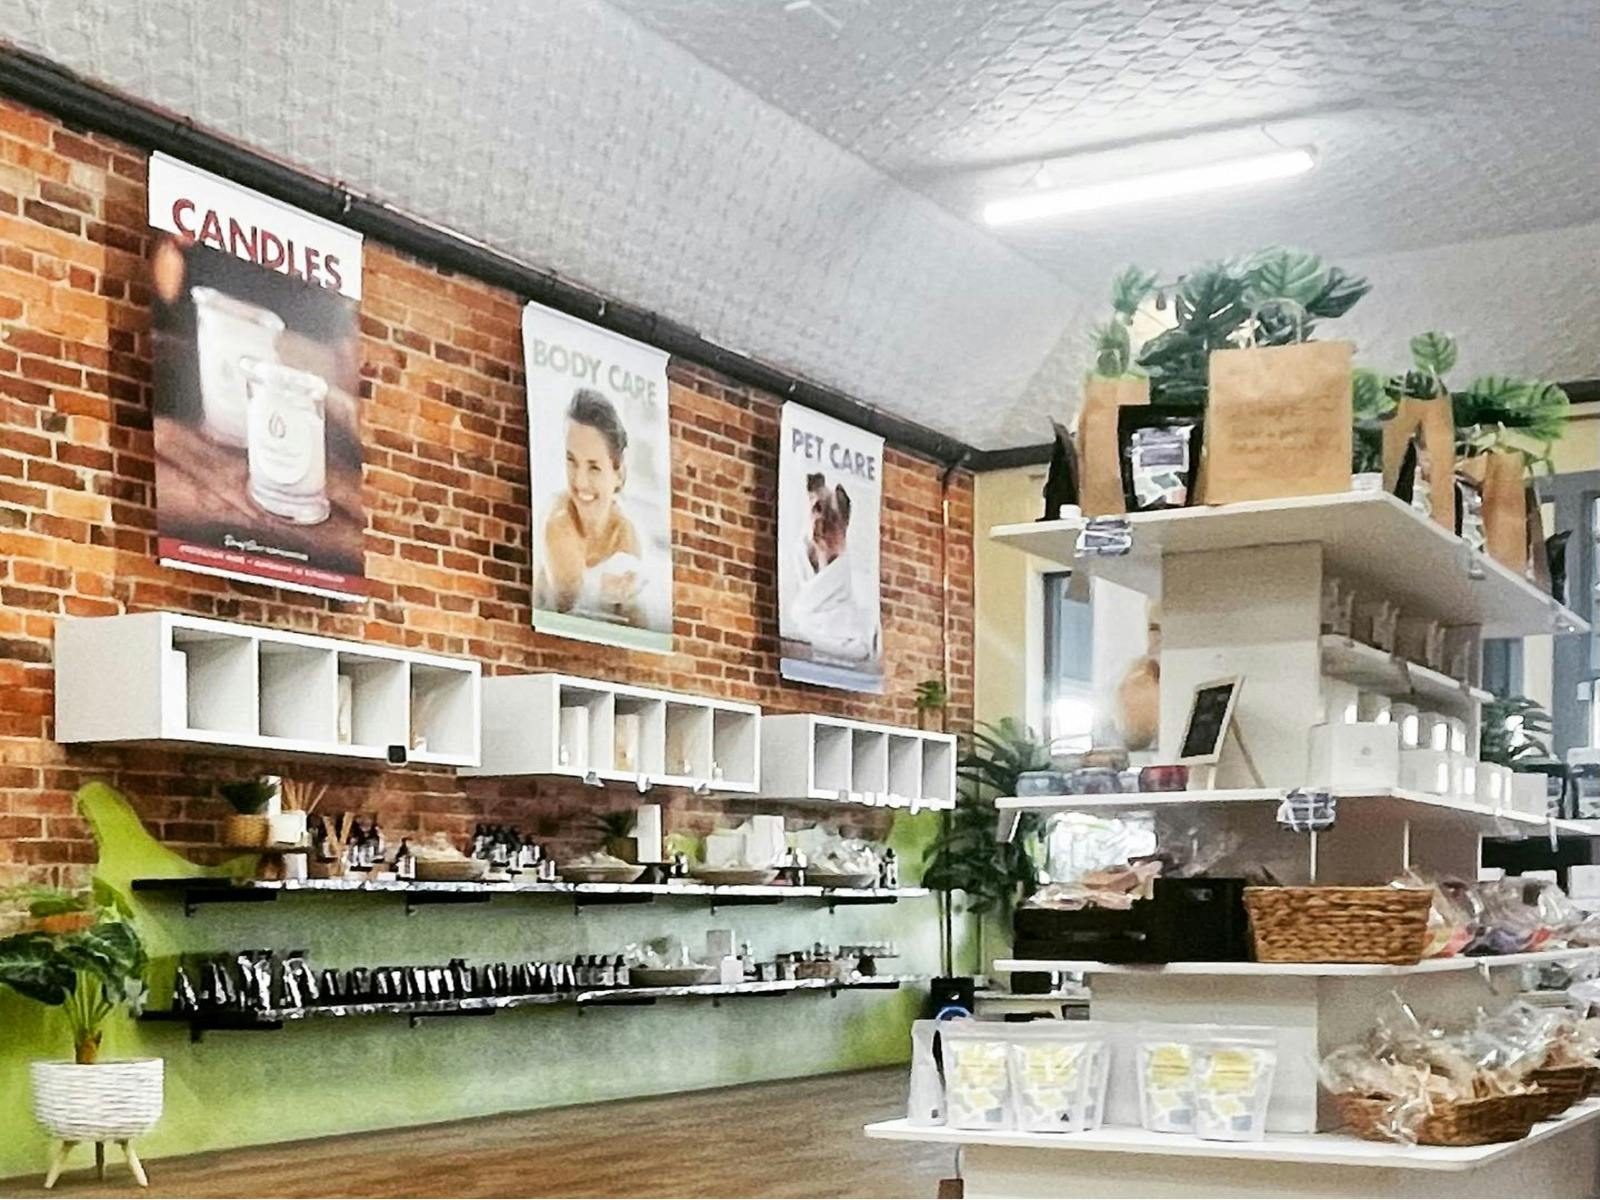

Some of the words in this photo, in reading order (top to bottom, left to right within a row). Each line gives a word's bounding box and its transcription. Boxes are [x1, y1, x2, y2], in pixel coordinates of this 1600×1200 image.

[172, 198, 342, 291] CANDLES
[533, 338, 602, 385] BODY
[608, 364, 657, 406] CARE
[792, 428, 824, 462] PET
[830, 442, 875, 481] CARE
